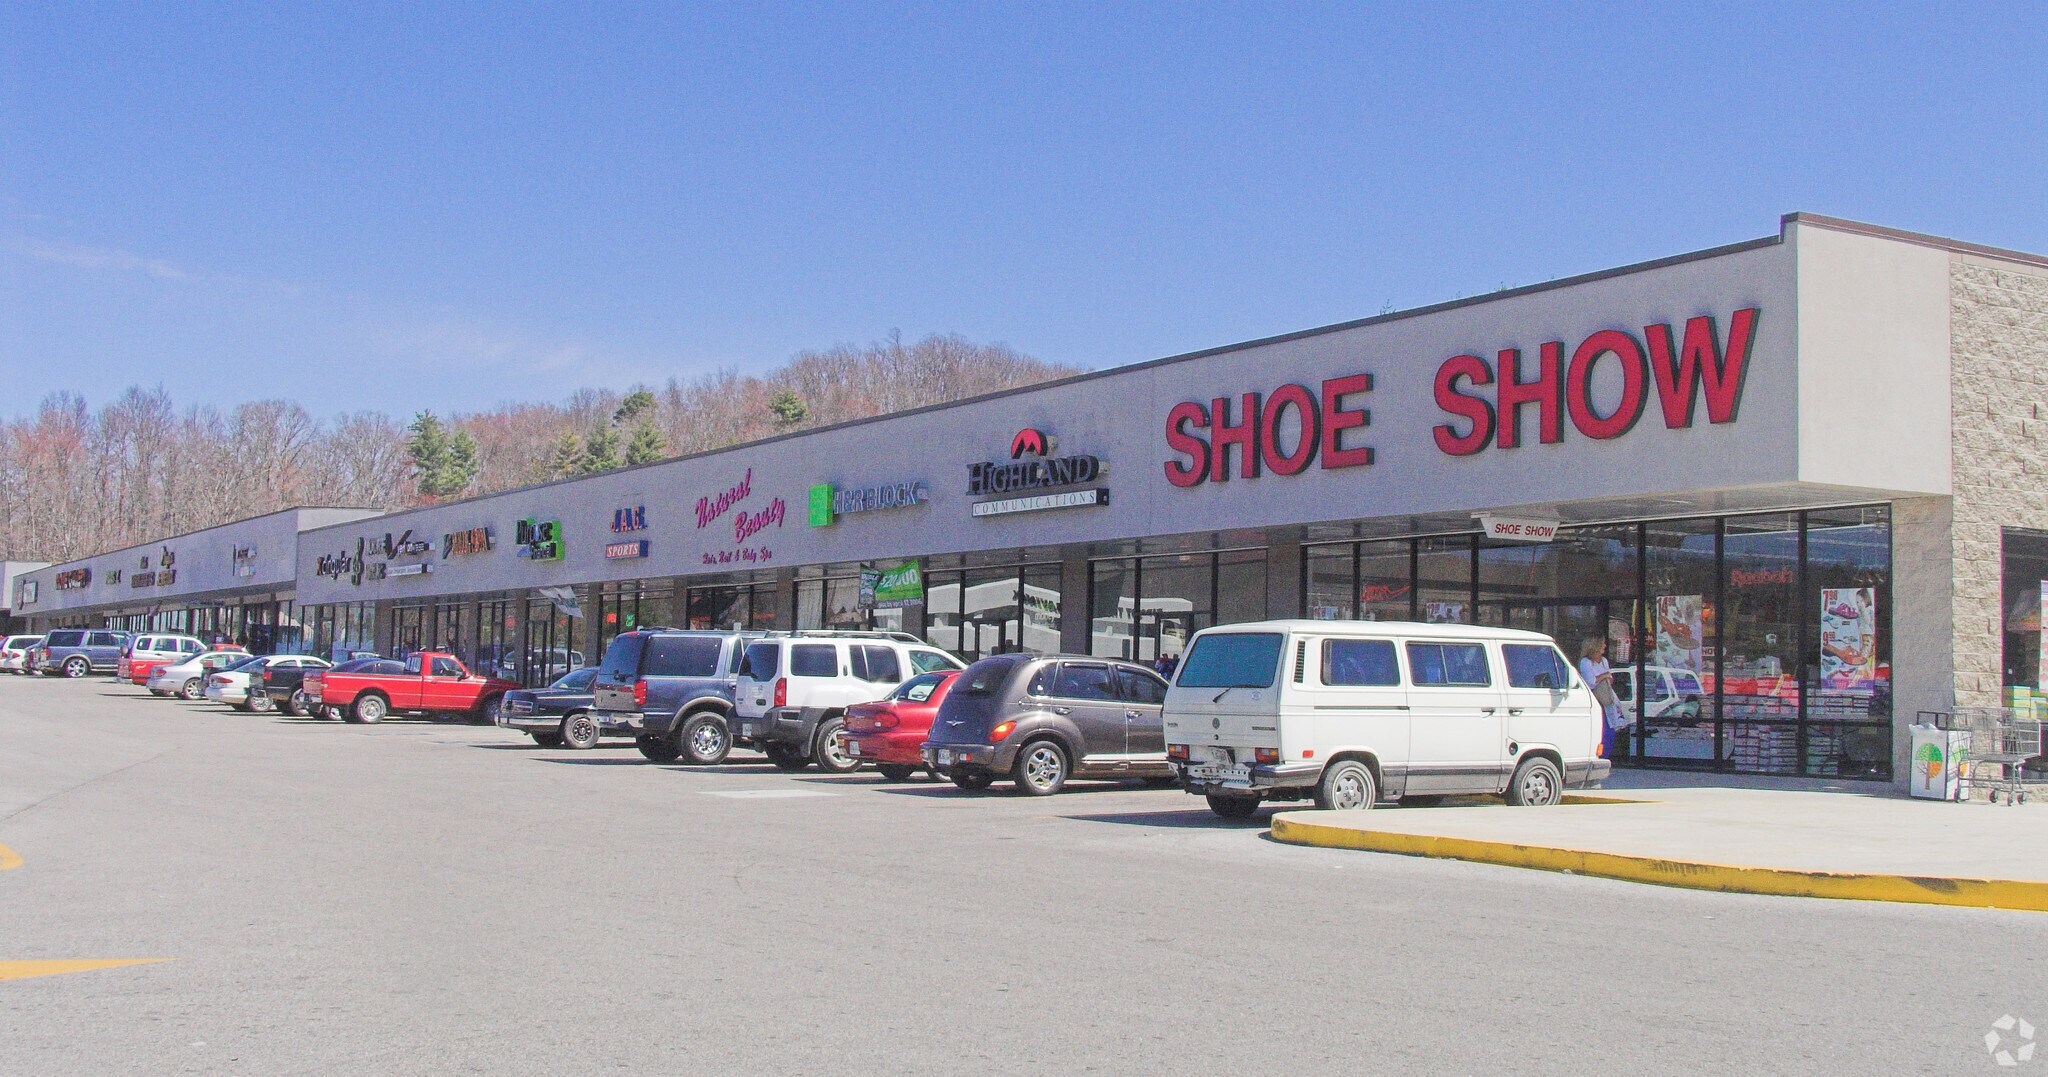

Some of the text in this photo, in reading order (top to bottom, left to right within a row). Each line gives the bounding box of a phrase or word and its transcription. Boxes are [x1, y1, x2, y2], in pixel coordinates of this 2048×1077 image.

[1164, 308, 1760, 488] SHOE SHOW
[966, 455, 1099, 496] HIGHLAND
[695, 467, 751, 529] Natural
[833, 481, 918, 514] H&R BLOCK
[974, 492, 1096, 515] COMMUNICATIONS
[734, 497, 786, 544] Beauty
[1495, 523, 1553, 537] SHOE SHOW
[607, 544, 638, 558] SPORTS
[760, 546, 772, 562] Spa
